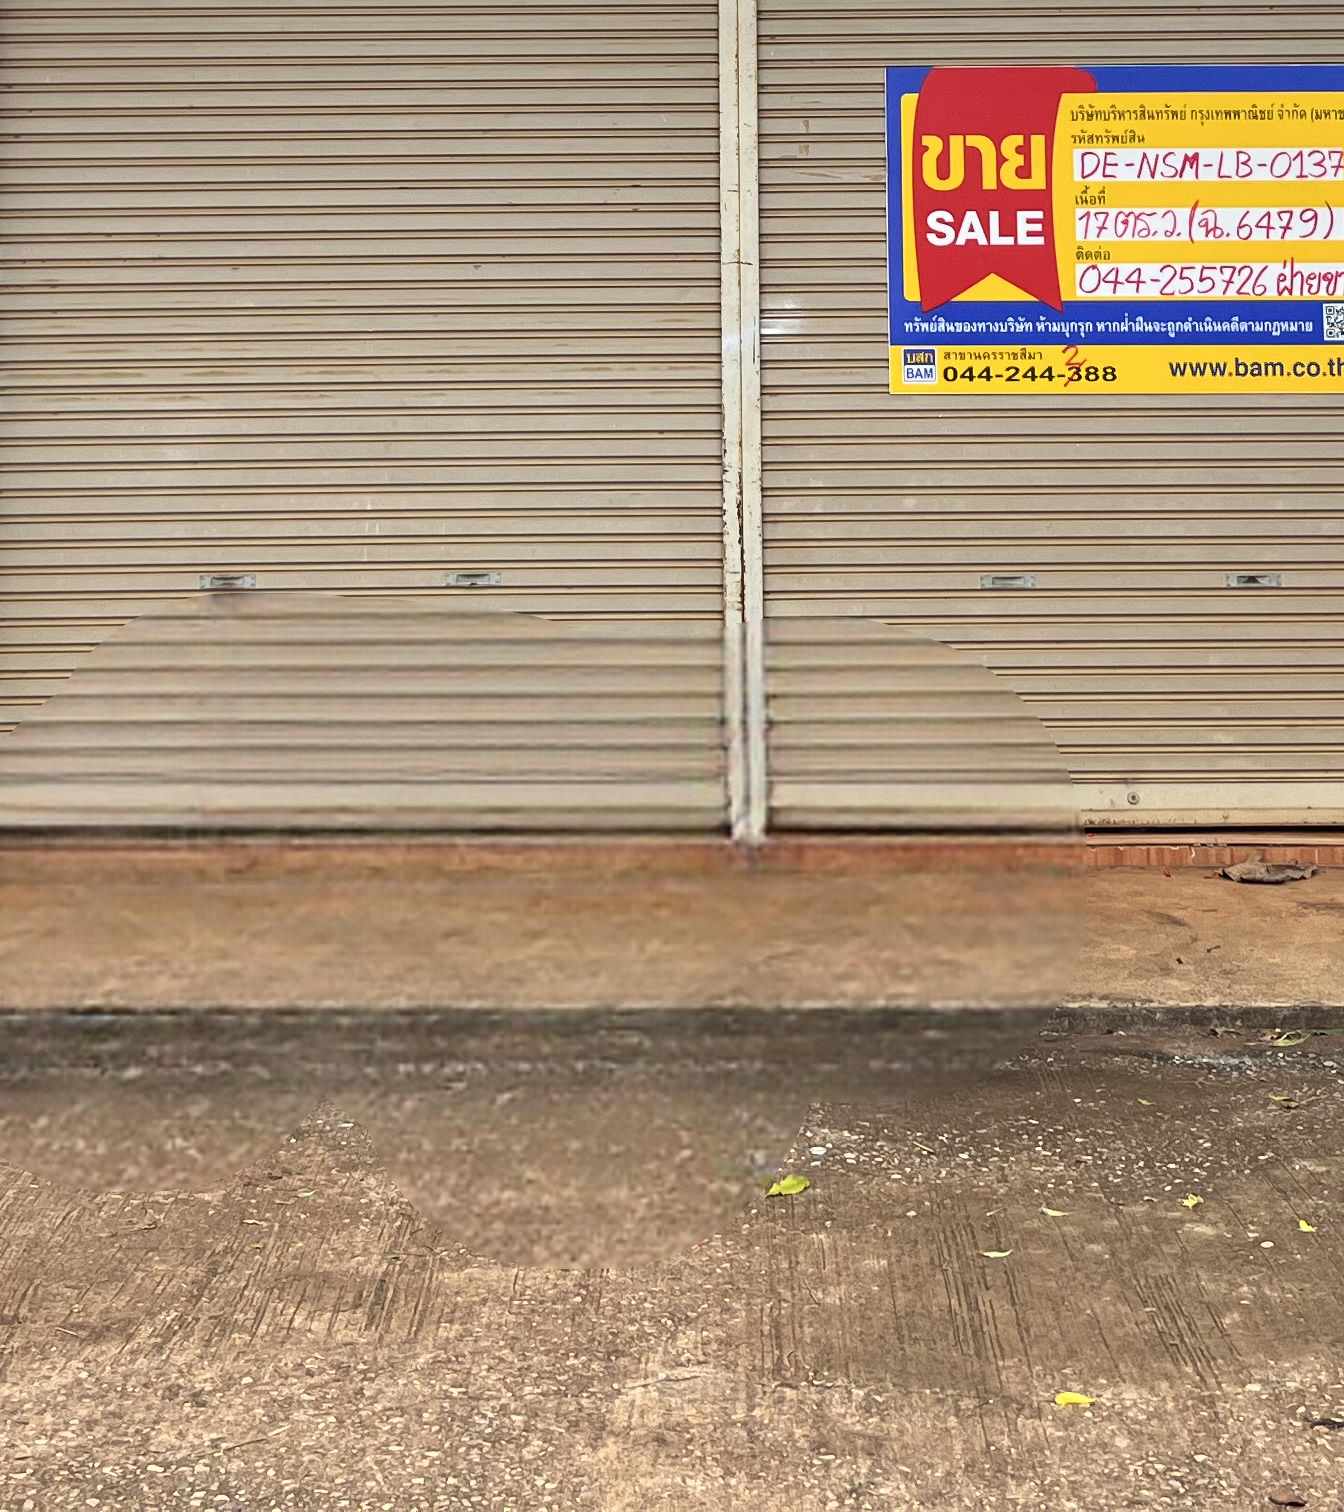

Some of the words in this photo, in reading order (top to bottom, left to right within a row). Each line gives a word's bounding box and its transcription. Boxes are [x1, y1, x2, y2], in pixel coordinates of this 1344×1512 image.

[1190, 104, 1275, 127] กรุงเทพพาณิชย์
[1277, 103, 1307, 120] จำกัด
[1071, 129, 1145, 144] รหัสทรัพย์สิน
[921, 134, 1047, 191] ขาย
[1080, 150, 1344, 180] DE-NSM-LB-0137
[1074, 186, 1106, 205] เนื้อที่
[926, 210, 1045, 246] SALE
[1075, 246, 1111, 261] ติดต่อ
[1079, 264, 1269, 296] 044-255726
[904, 315, 1033, 333] ทรัพย์สินของทางบริษัท
[1036, 316, 1093, 338] ห้ามบุกรุก
[943, 349, 1043, 360] สาขานครราชสีมา
[906, 368, 934, 379] BAM
